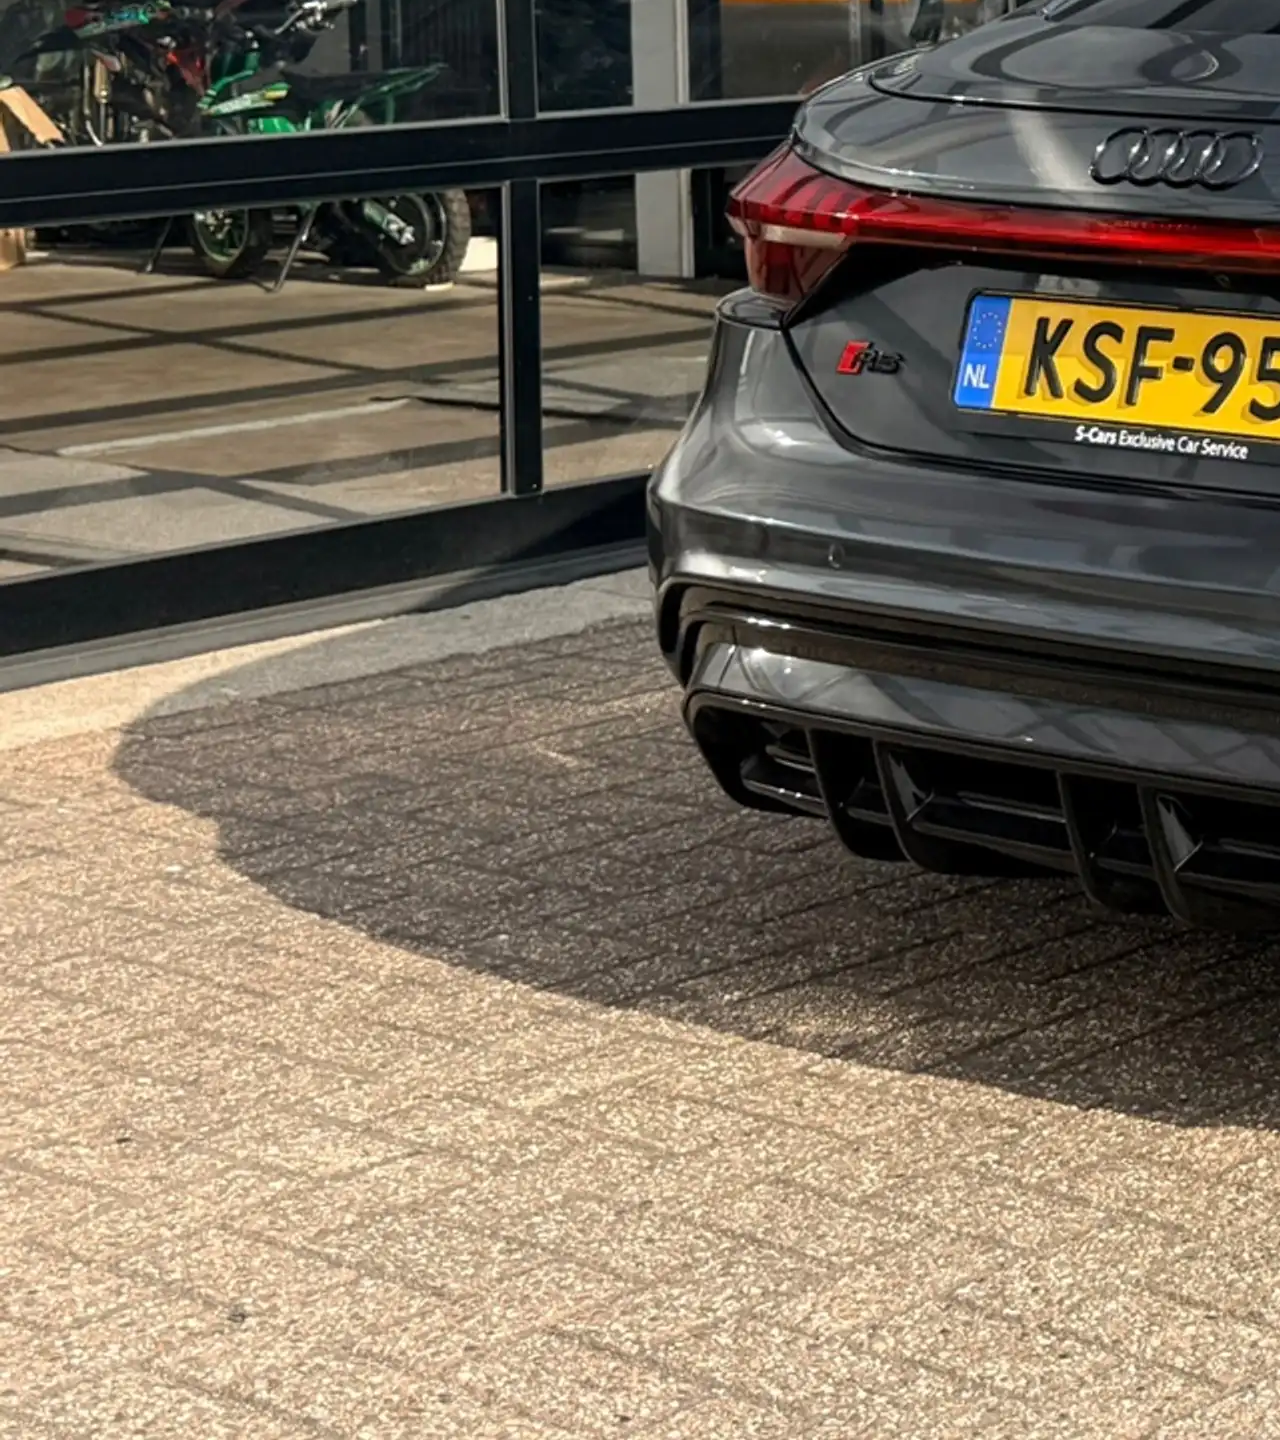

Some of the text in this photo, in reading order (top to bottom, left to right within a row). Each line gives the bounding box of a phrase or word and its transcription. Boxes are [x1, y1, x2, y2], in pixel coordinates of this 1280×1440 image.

[963, 362, 990, 389] NL
[1074, 425, 1249, 460] S-Cars Exclusive Car Service
